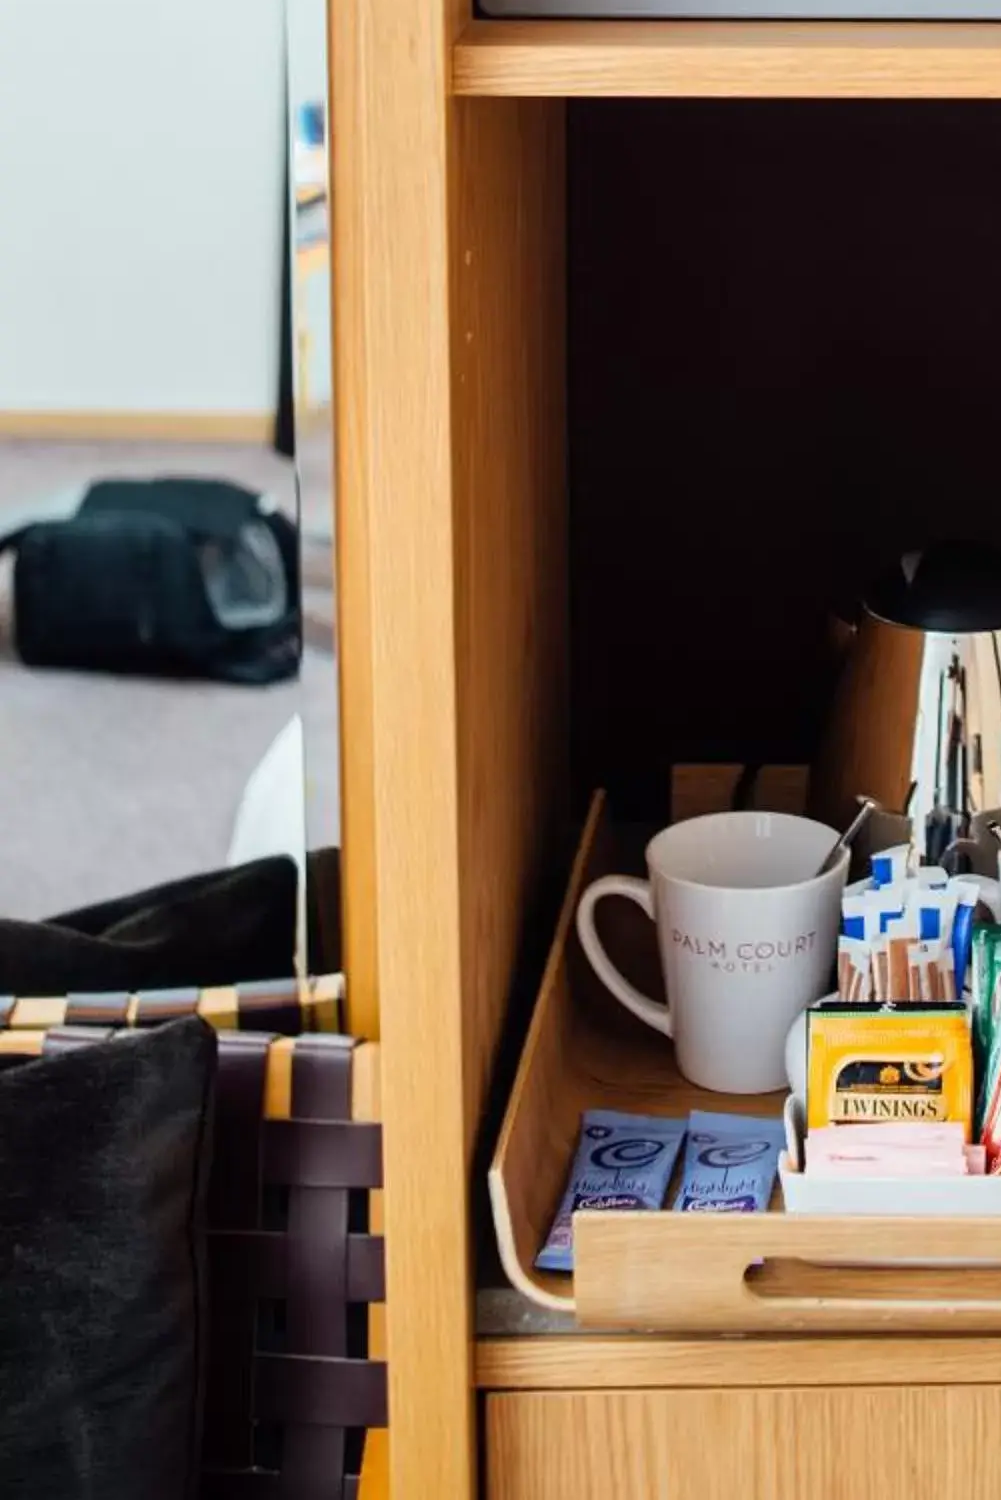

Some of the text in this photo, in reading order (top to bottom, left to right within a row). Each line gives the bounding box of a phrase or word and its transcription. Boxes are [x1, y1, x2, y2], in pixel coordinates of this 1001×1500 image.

[671, 928, 817, 960] PALM COURT
[842, 1098, 938, 1117] TWININGS
